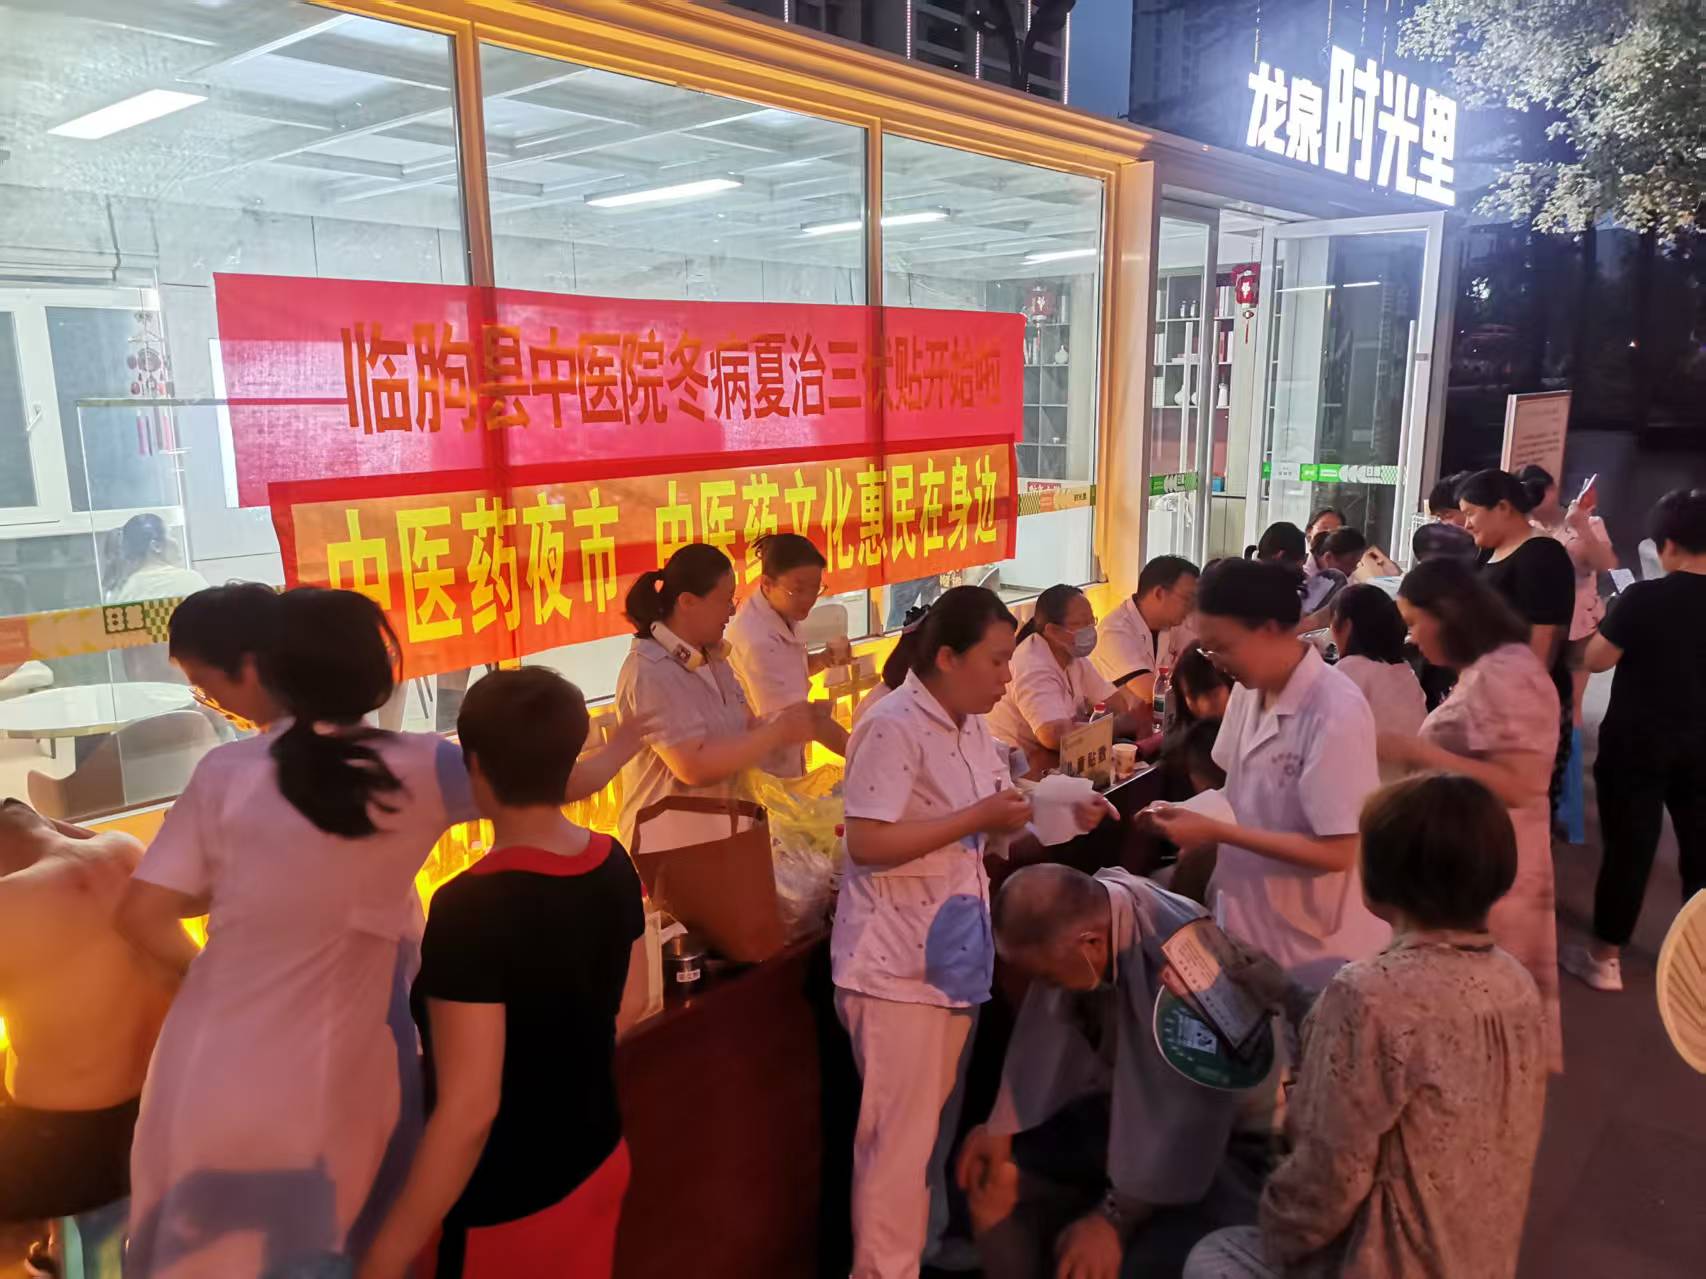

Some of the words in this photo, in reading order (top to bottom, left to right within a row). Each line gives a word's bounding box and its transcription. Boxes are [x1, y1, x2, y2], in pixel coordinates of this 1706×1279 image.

[1247, 45, 1457, 206] 龙泉时光里
[327, 488, 619, 643] 中医药夜市
[656, 454, 998, 584] 中医药文化惠民在身边
